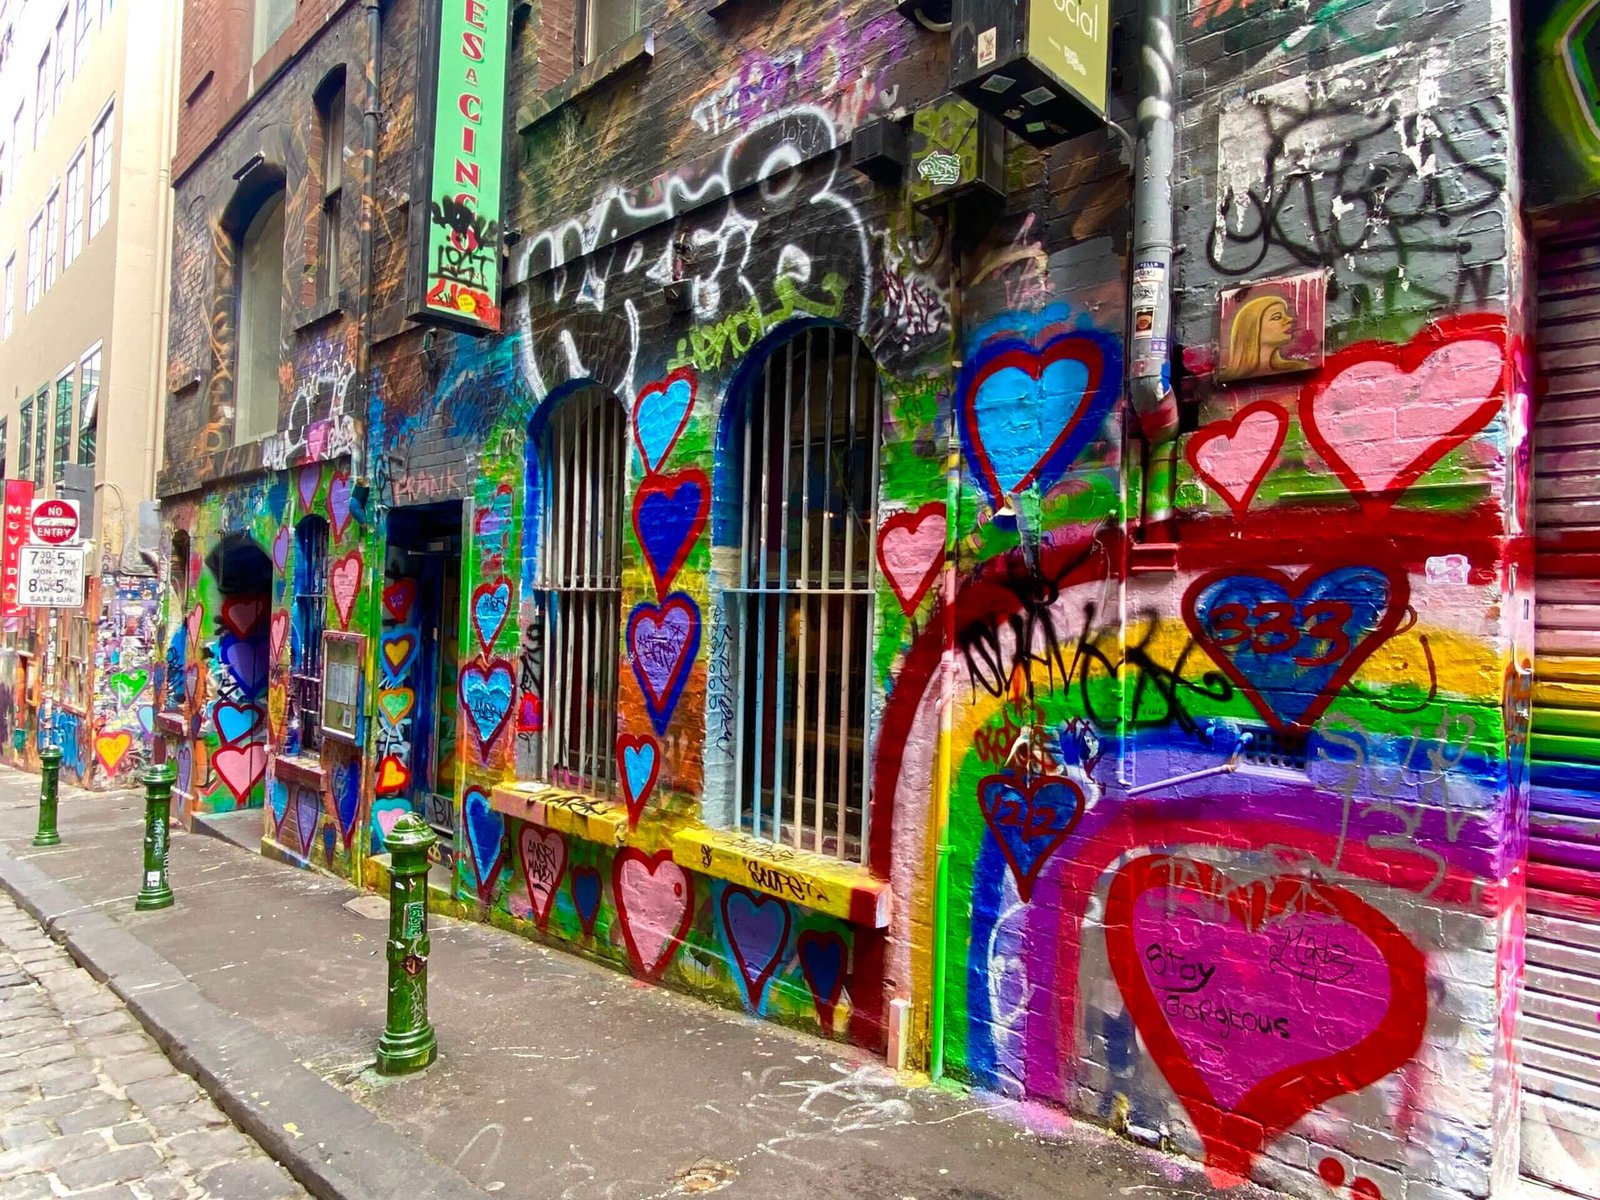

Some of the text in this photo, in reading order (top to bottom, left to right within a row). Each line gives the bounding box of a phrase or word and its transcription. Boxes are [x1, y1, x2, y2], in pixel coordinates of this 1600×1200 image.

[48, 507, 63, 516] NO
[37, 527, 71, 537] ENTRY
[29, 551, 39, 565] 7
[57, 552, 66, 566] 5
[28, 579, 37, 592] 8
[56, 580, 64, 593] 5
[1208, 601, 1354, 667] 333
[1146, 943, 1217, 993] Stay
